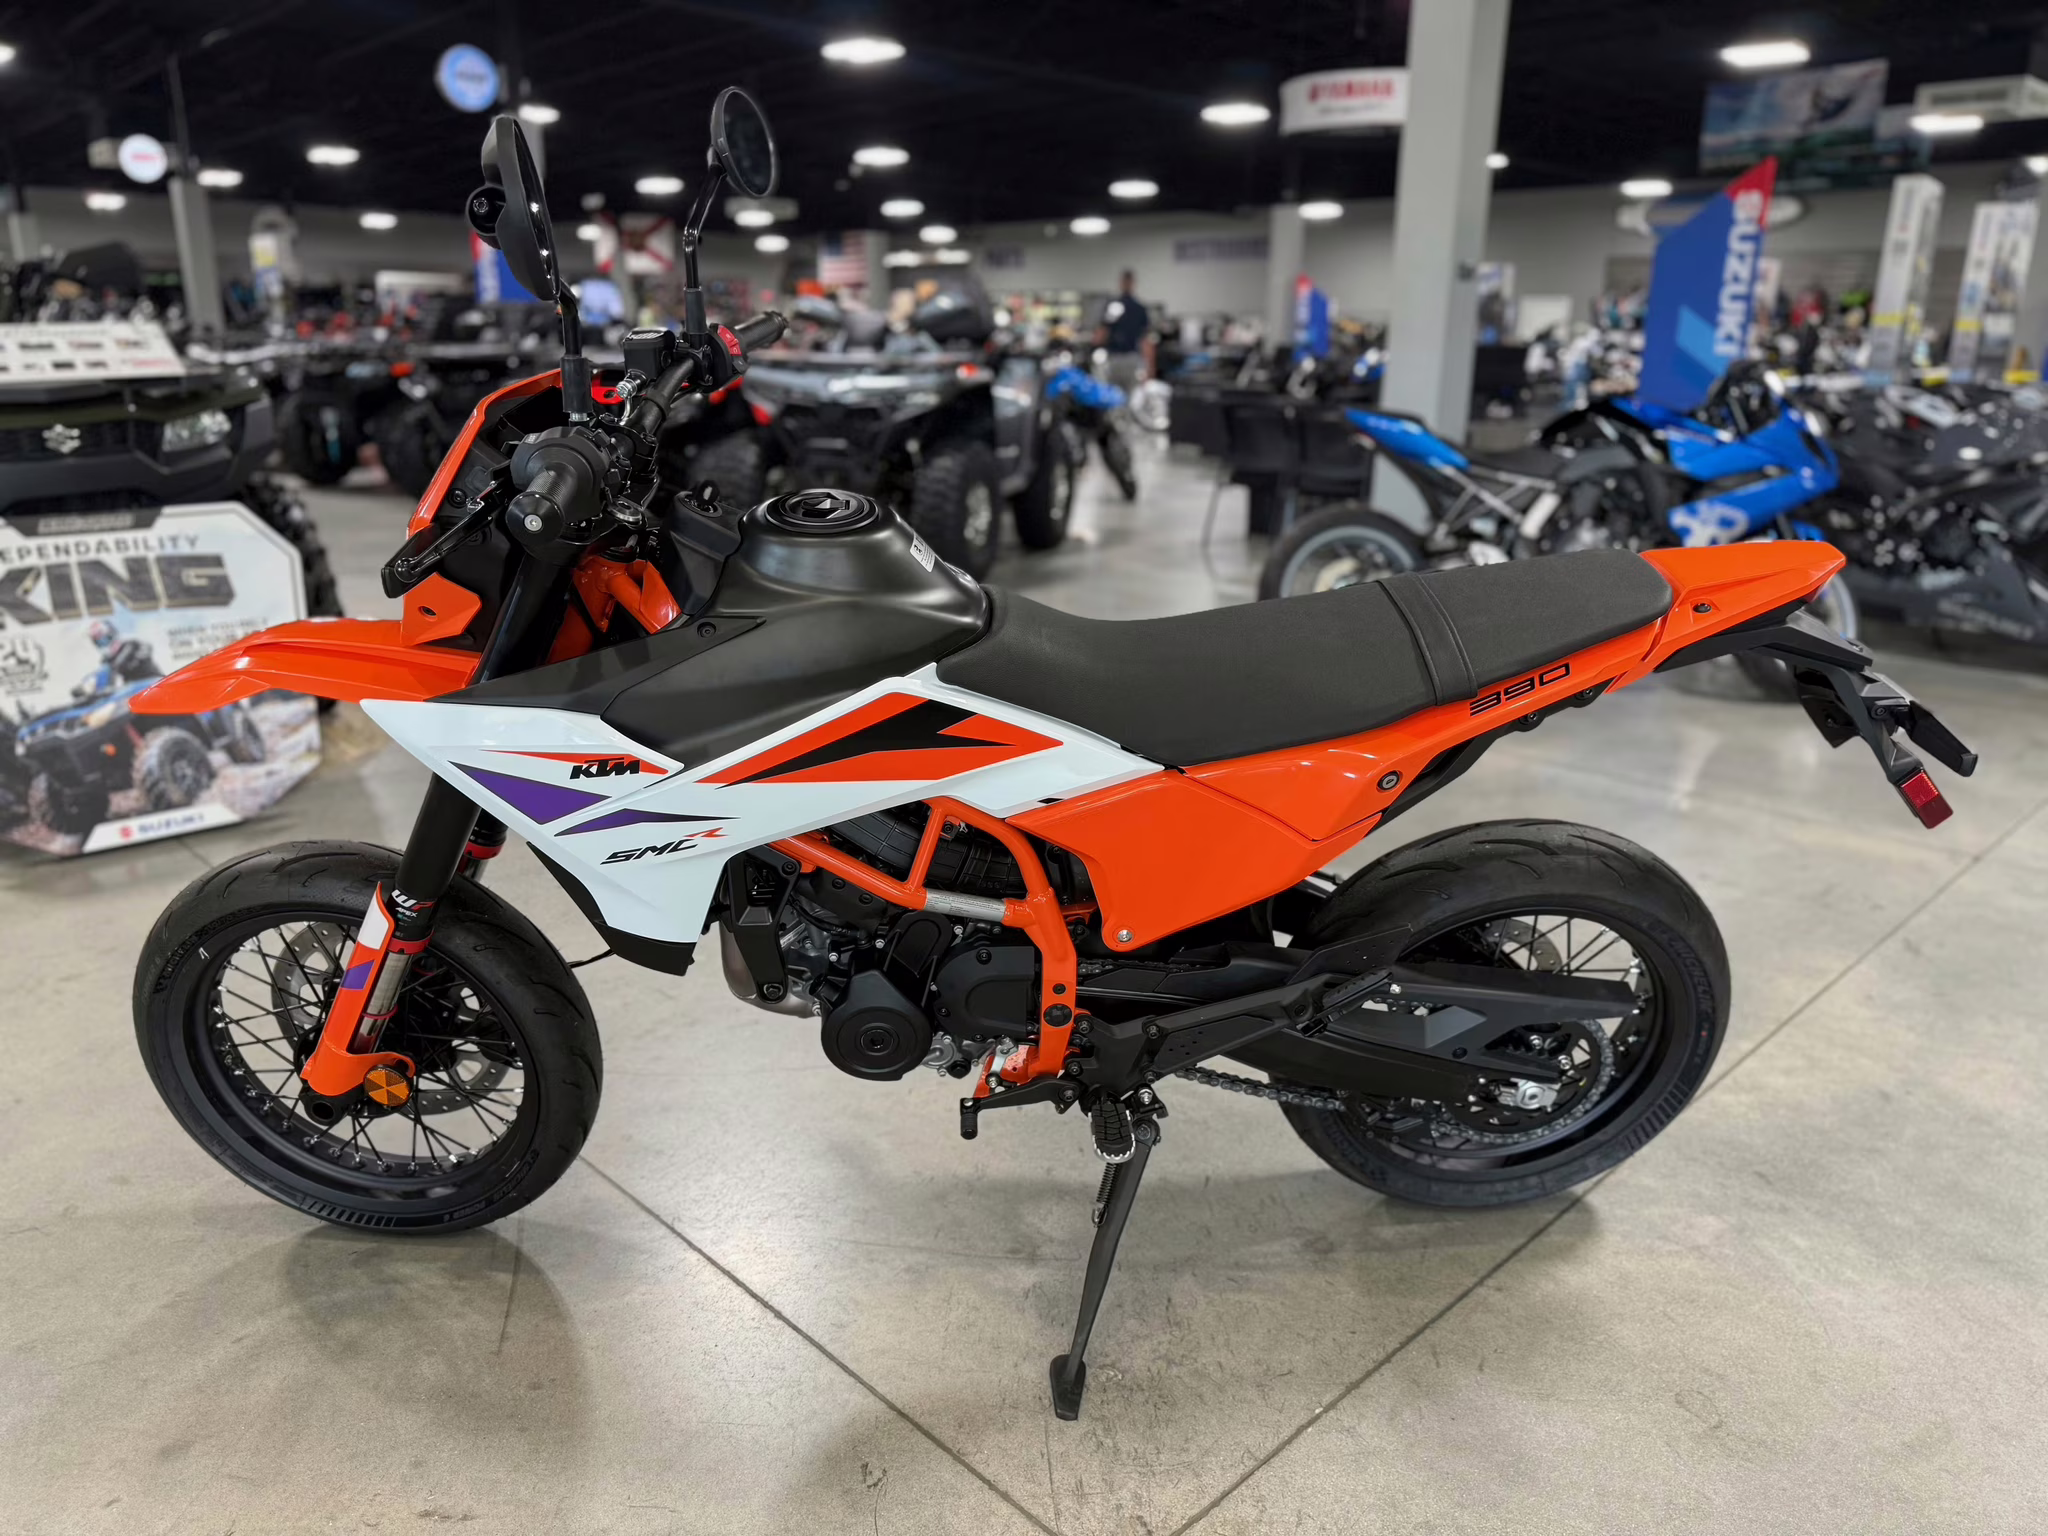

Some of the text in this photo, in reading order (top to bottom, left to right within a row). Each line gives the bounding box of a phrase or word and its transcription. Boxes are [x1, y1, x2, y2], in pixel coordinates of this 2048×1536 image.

[1713, 188, 1764, 356] SUZUKI
[0, 534, 199, 565] EPENDABILITY
[1469, 662, 1571, 717] 390
[569, 757, 640, 780] KTM
[599, 838, 699, 866] SMC
[391, 889, 433, 912] WP
